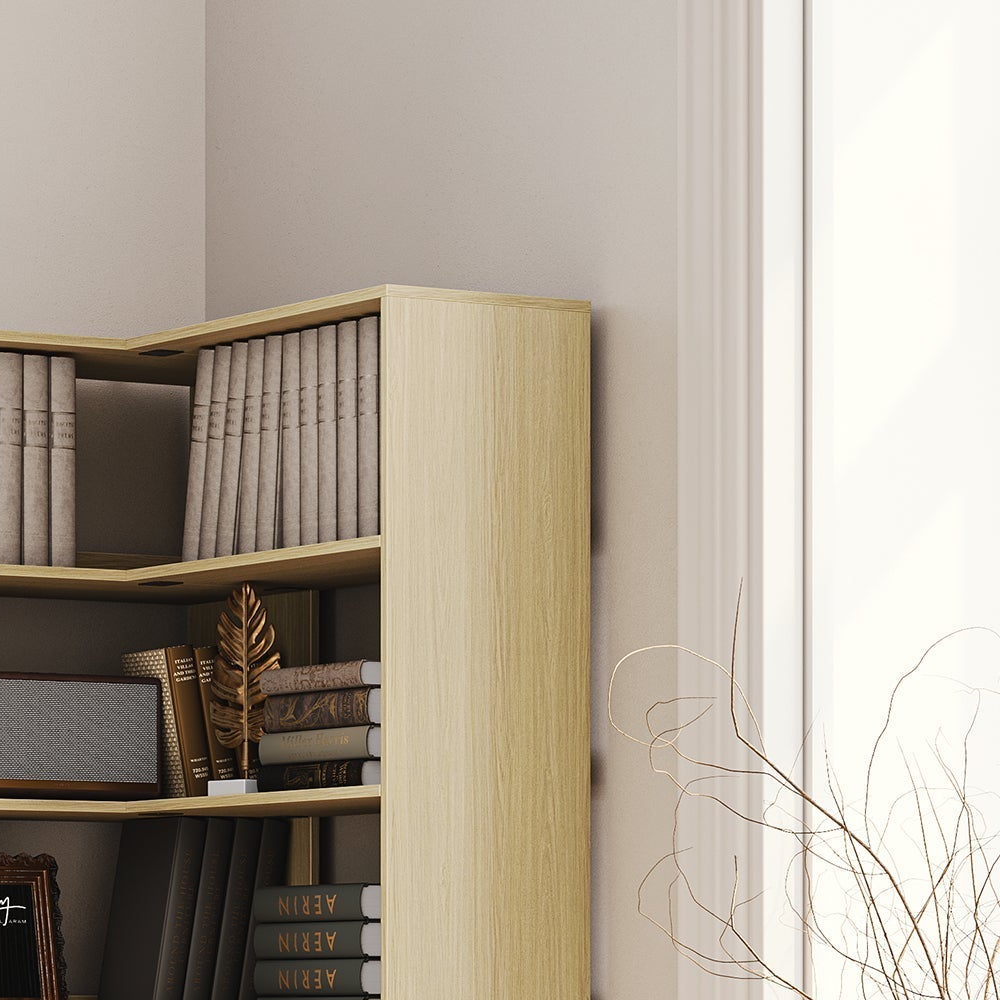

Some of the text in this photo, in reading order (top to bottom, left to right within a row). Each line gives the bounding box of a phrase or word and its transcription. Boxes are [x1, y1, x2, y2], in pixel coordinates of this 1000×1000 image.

[278, 894, 337, 915] AERIN
[278, 932, 337, 952] AERIN
[278, 969, 337, 989] AERIN
